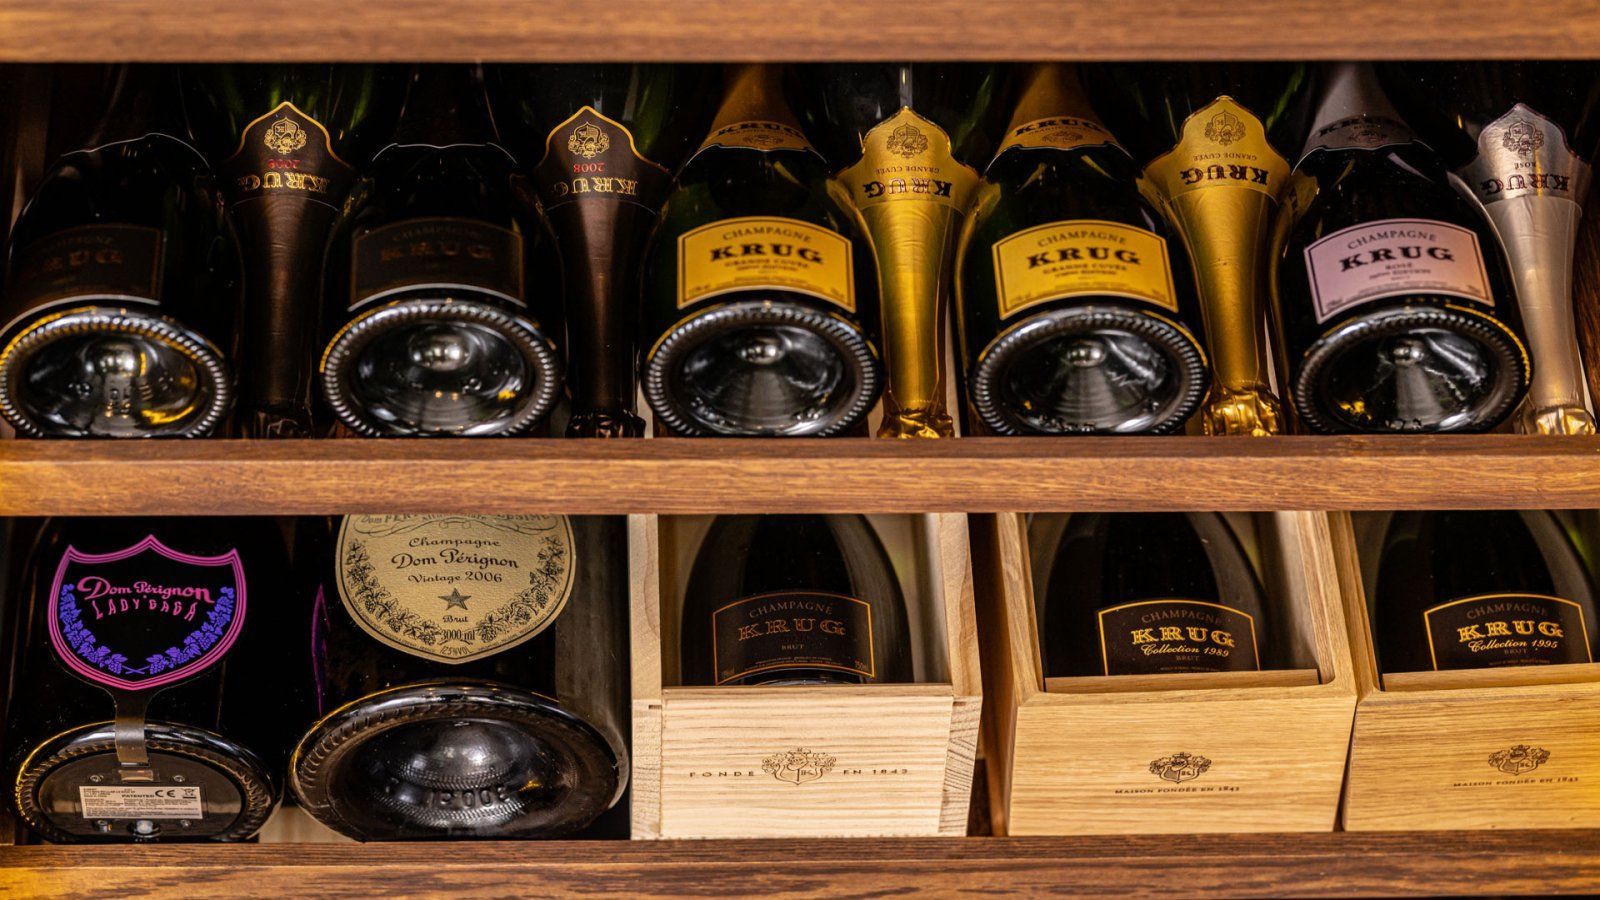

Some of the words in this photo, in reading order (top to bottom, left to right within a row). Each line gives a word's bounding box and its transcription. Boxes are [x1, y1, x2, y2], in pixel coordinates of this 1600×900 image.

[1224, 152, 1257, 161] GRANDE
[573, 162, 606, 173] 2008
[906, 165, 940, 175] GRANDE
[1180, 164, 1269, 186] KRUG
[553, 176, 639, 197] KRUG
[862, 178, 953, 199] KRUG
[1480, 173, 1569, 195] KRUG
[722, 227, 811, 243] CHAMPAGNE
[1037, 231, 1126, 247] CHAMPAGNE
[1347, 230, 1438, 249] CHAMPAGNE
[710, 243, 823, 265] KRUG
[1028, 246, 1141, 269] KRUG
[1340, 246, 1455, 272] KRUG
[408, 539, 502, 550] Champagne
[391, 553, 437, 570] Dom
[439, 549, 520, 571] Pérignon
[407, 575, 461, 585] Vintage
[464, 571, 503, 584] 2006
[76, 576, 133, 601] Dom
[132, 581, 216, 604] Pérignon
[92, 599, 141, 620] LADY
[148, 599, 199, 621] GAGA
[749, 600, 833, 619] CHAMPAGNE
[1141, 610, 1221, 625] CHAMPAGNE
[1466, 603, 1547, 620] CHAMPAGNE
[442, 615, 468, 624] Brut
[440, 629, 462, 640] 3000
[463, 630, 475, 640] ml
[738, 618, 847, 642] KRUG
[1131, 625, 1236, 648] KRUG
[1456, 620, 1564, 643] KRUG
[780, 643, 805, 651] BRUT
[1140, 644, 1200, 656] Collection
[1203, 647, 1229, 657] 1989
[1467, 639, 1528, 653] Collection
[1531, 639, 1558, 649] 1995
[1218, 785, 1241, 793] 1843
